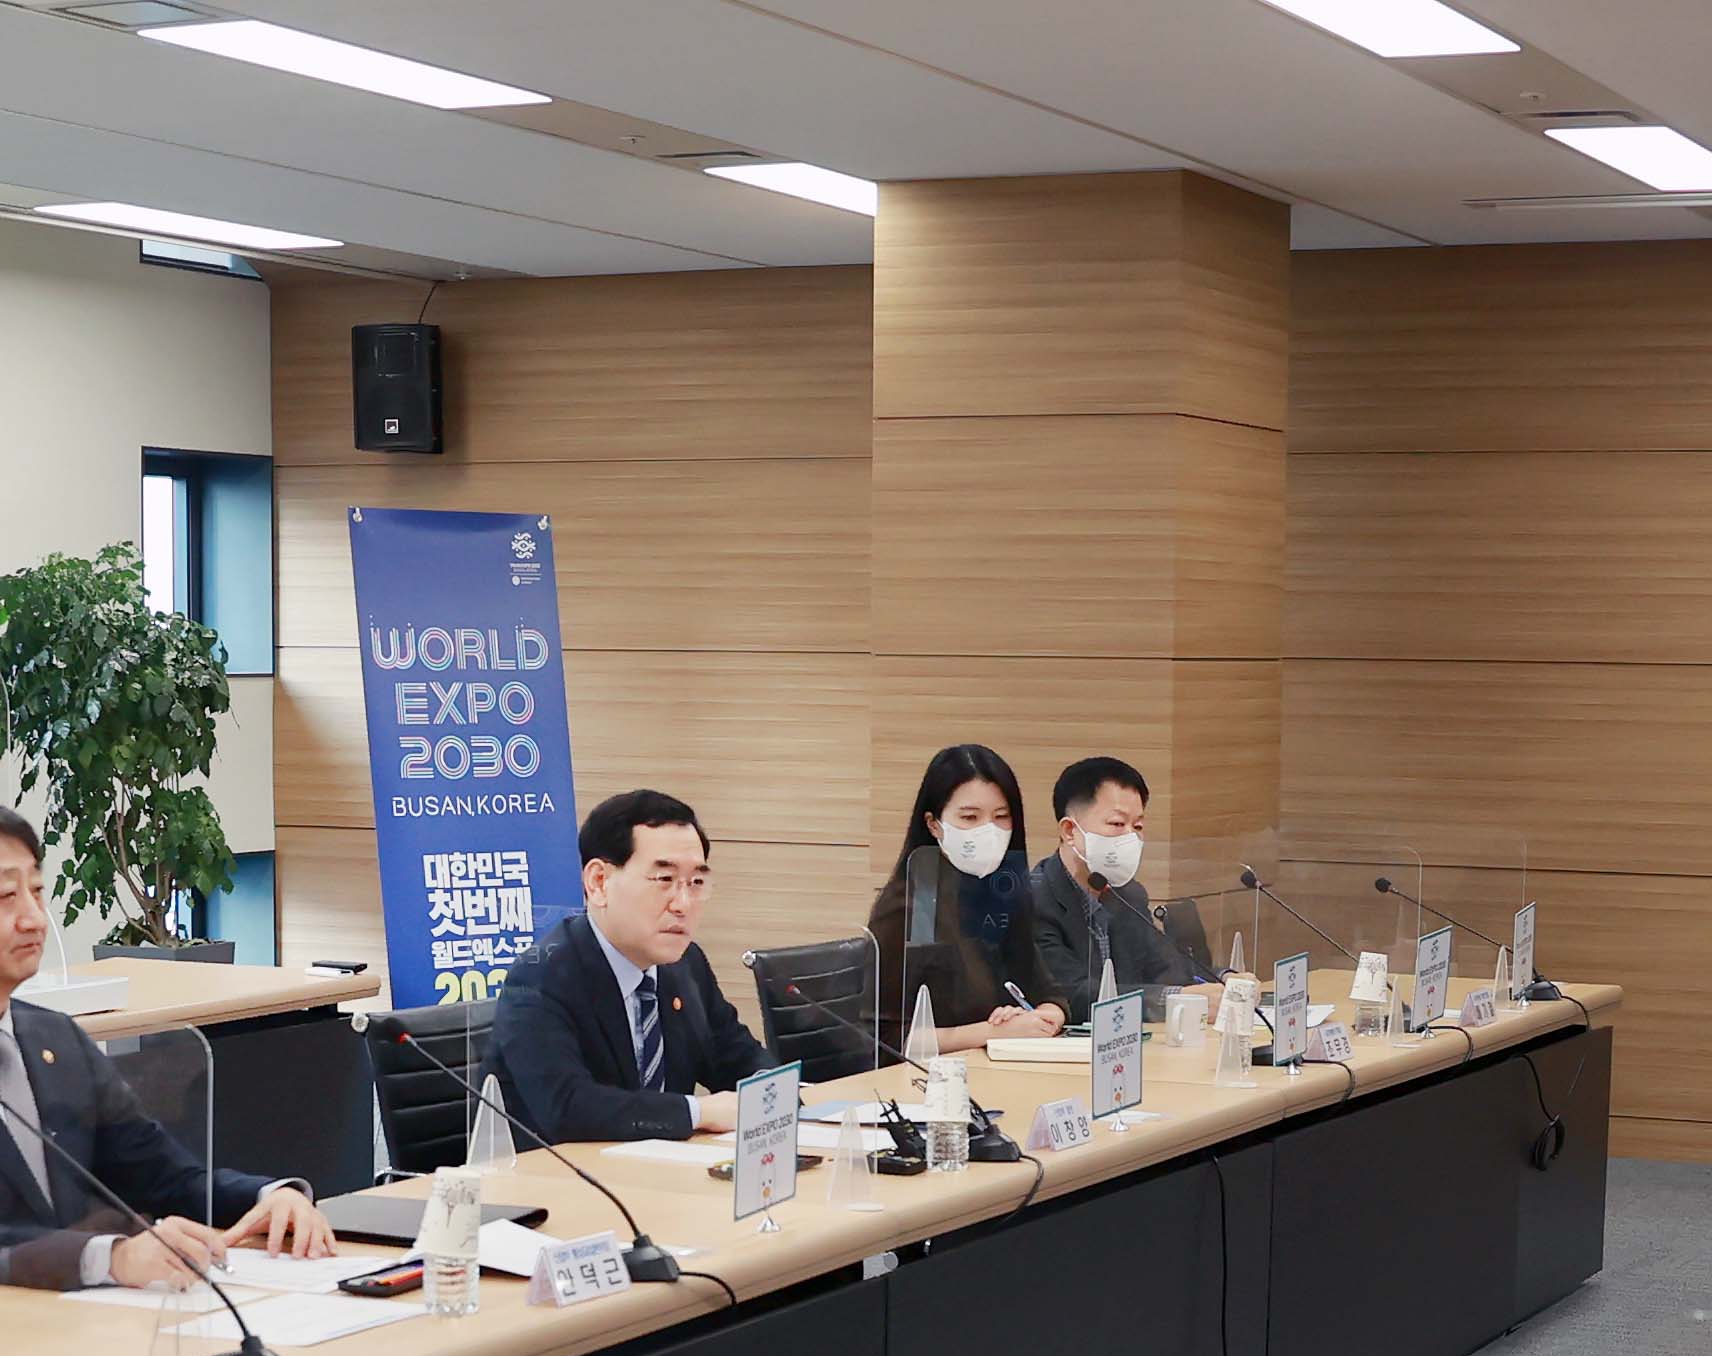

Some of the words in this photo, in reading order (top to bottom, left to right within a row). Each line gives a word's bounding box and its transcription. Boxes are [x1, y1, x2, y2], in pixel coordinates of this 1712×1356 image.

[371, 625, 549, 671] WORLD
[395, 680, 536, 726] EXPO
[398, 733, 541, 780] 2030
[423, 850, 530, 889] 대한민국
[427, 886, 535, 938] 첫번째
